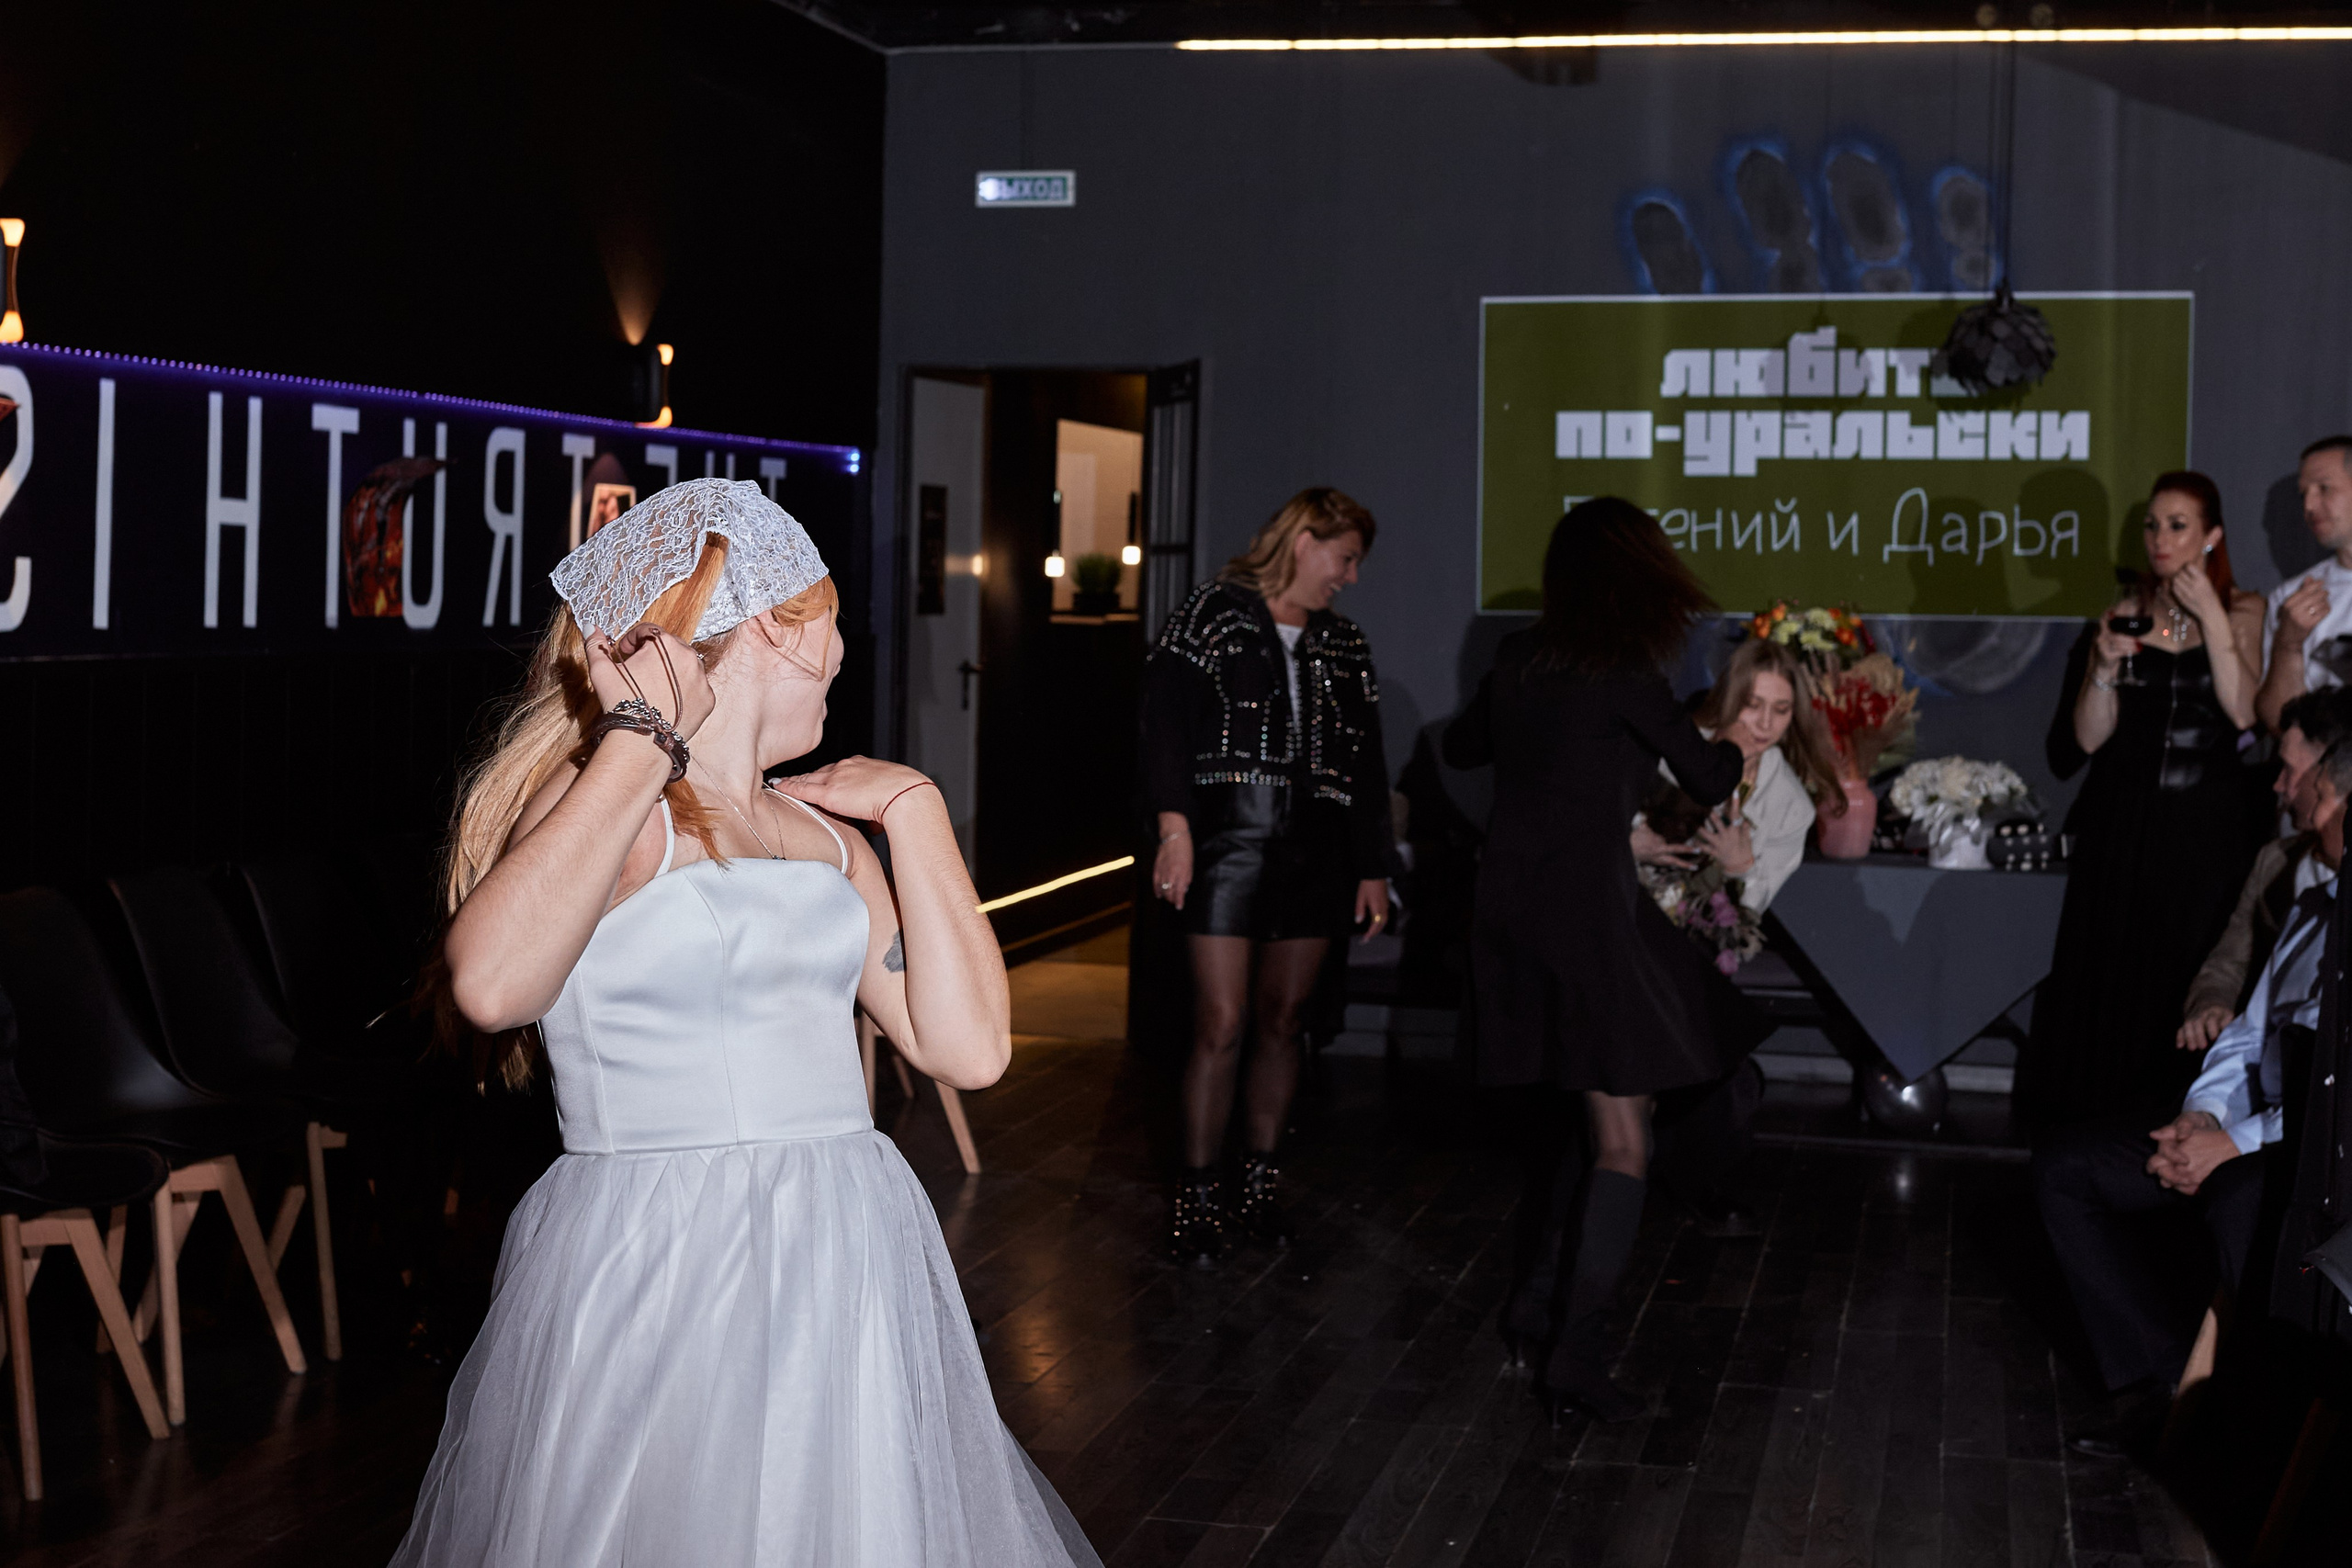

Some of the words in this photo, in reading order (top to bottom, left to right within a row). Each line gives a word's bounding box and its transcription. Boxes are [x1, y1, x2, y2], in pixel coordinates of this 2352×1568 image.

[980, 177, 1064, 200] ЫХОД
[1555, 410, 2090, 477] по-уральски
[1564, 495, 1801, 555] ений
[1827, 511, 1859, 555] и
[1883, 488, 2079, 566] Дарья
